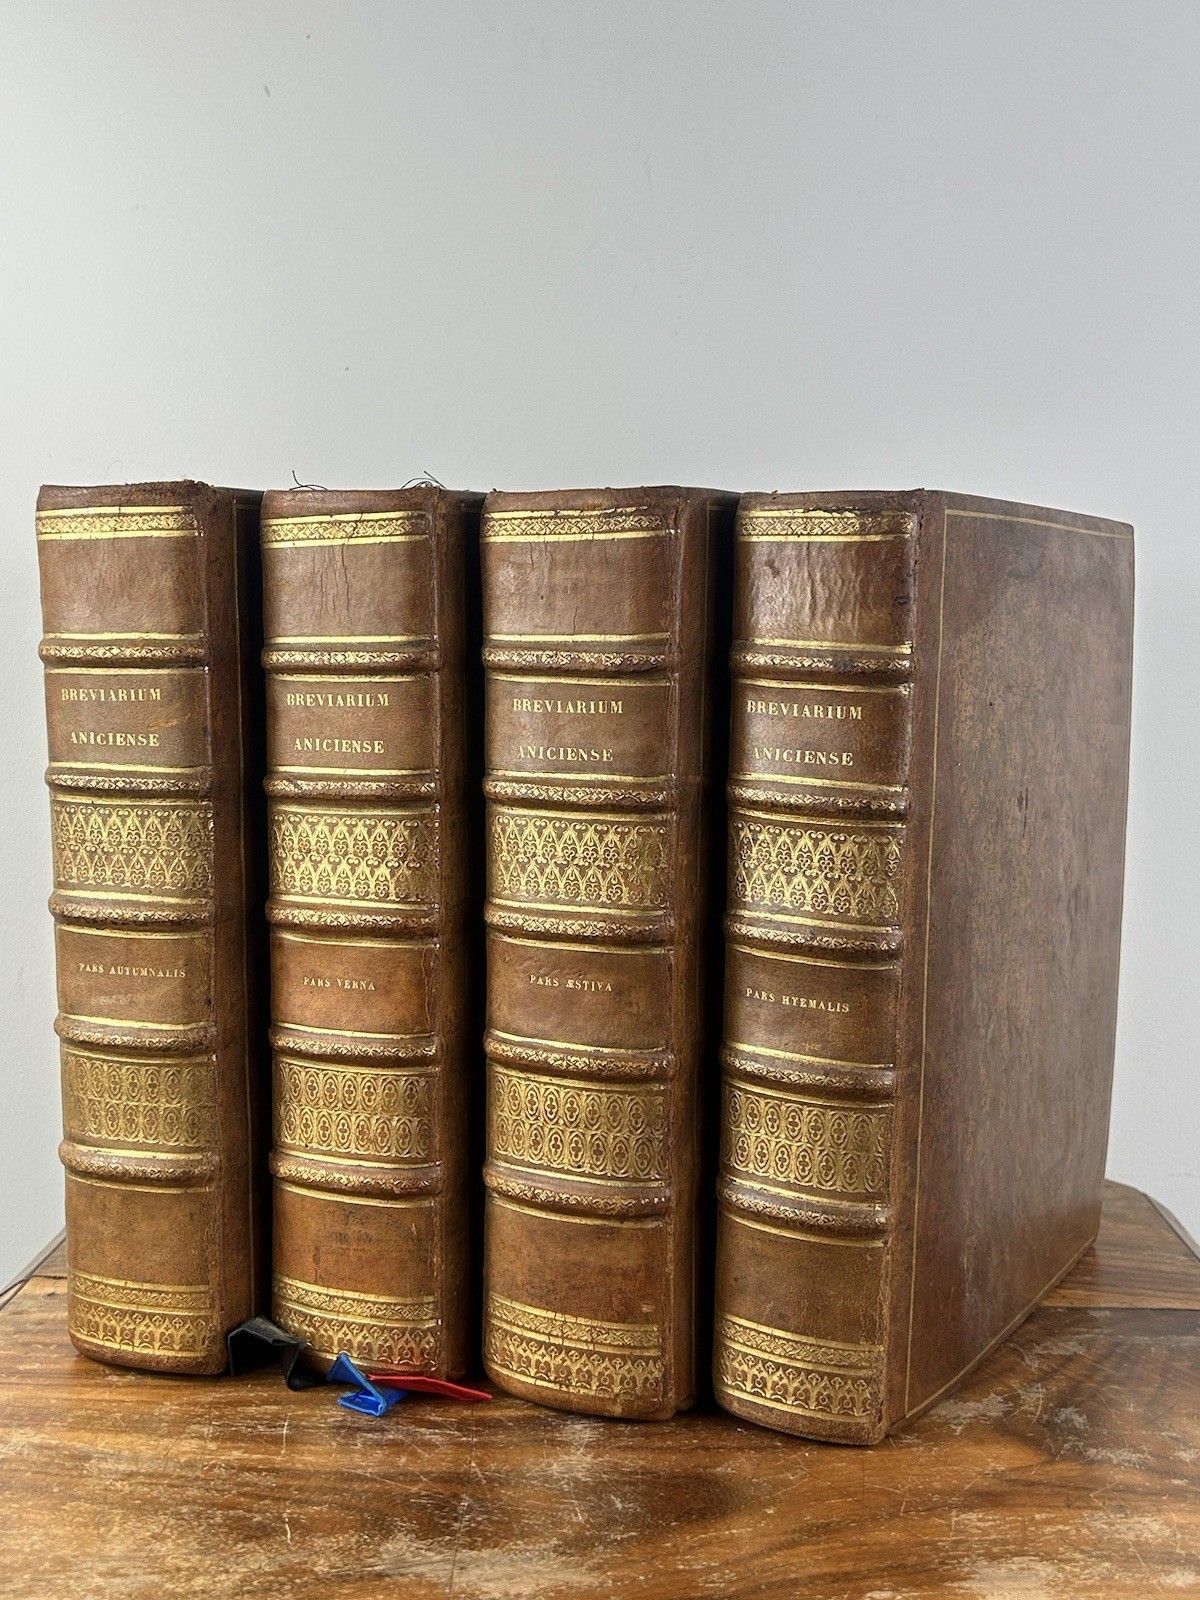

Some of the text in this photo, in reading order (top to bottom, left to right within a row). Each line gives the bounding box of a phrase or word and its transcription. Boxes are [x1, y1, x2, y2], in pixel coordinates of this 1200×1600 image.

[61, 687, 161, 702] BREVIARIUM
[286, 692, 390, 707] BREVIARIUM
[513, 698, 623, 714] BREVIARIUM
[747, 699, 862, 720] BREVIARIUM
[70, 731, 160, 747] ANICIENSE
[294, 737, 385, 753] ANICIENSE
[518, 745, 614, 761] ANICIENSE
[754, 747, 854, 766] ANICIENSE
[79, 962, 186, 978] PARS AUTUMNALIS
[303, 976, 376, 991] PARS VERNA
[530, 974, 612, 992] PARS ÆSTIVA
[745, 987, 850, 1013] PARS HYEMALIS
